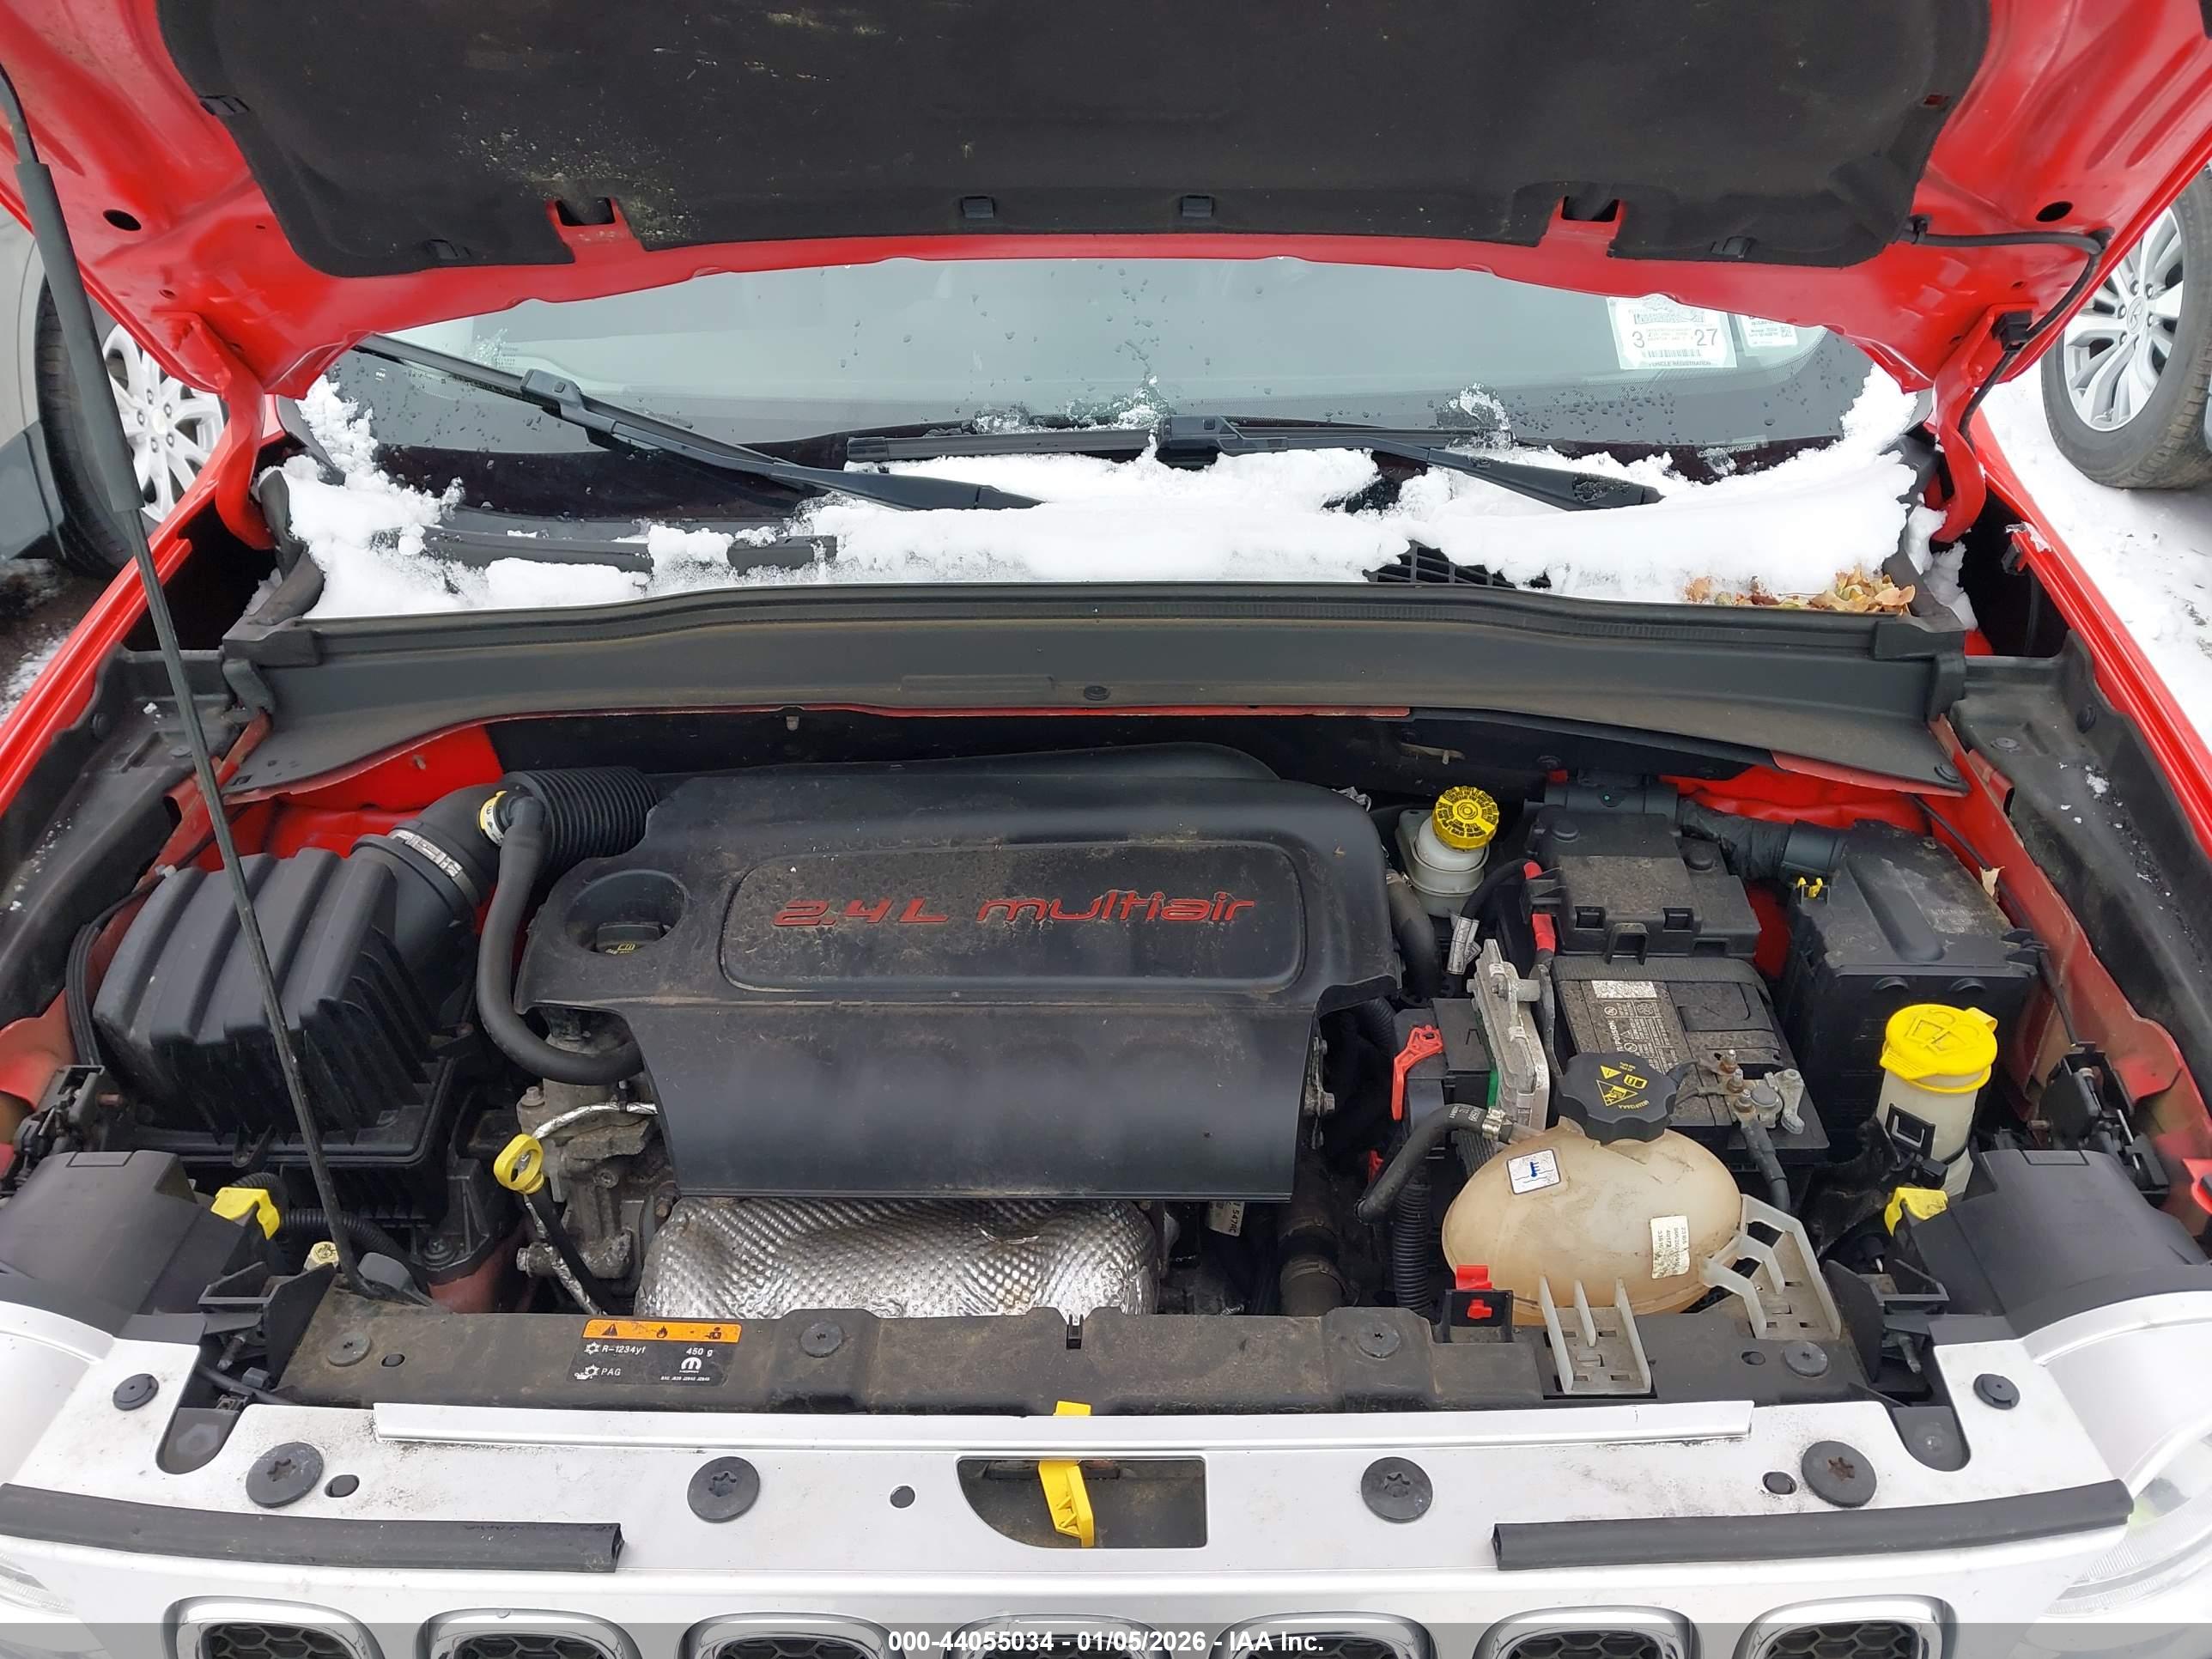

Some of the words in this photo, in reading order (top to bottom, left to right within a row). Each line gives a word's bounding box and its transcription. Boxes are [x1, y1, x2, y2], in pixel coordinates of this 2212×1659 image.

[1632, 331, 1645, 349] 3
[1694, 328, 1718, 347] 27
[977, 889, 1255, 923] multiair
[686, 1347, 703, 1356] 450
[706, 1349, 714, 1358] g
[601, 1367, 622, 1376] PAG
